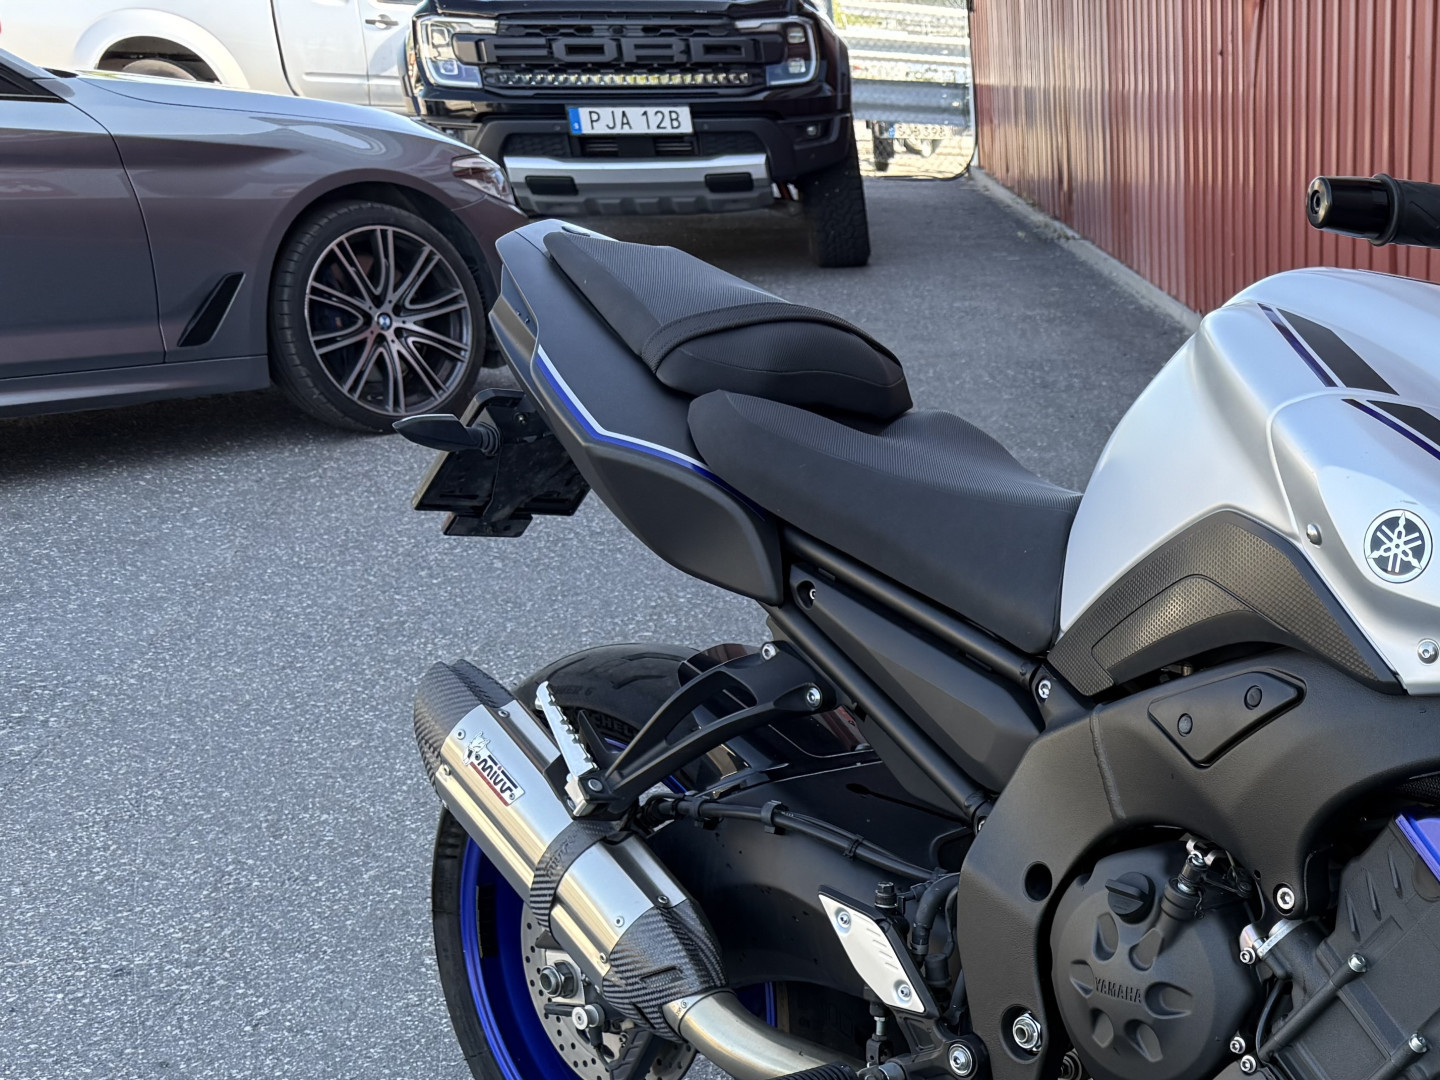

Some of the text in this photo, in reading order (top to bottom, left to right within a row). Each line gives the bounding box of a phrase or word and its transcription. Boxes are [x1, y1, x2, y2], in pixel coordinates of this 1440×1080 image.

[589, 110, 682, 130] PJA 12B
[1095, 976, 1142, 1003] YAMAHA
